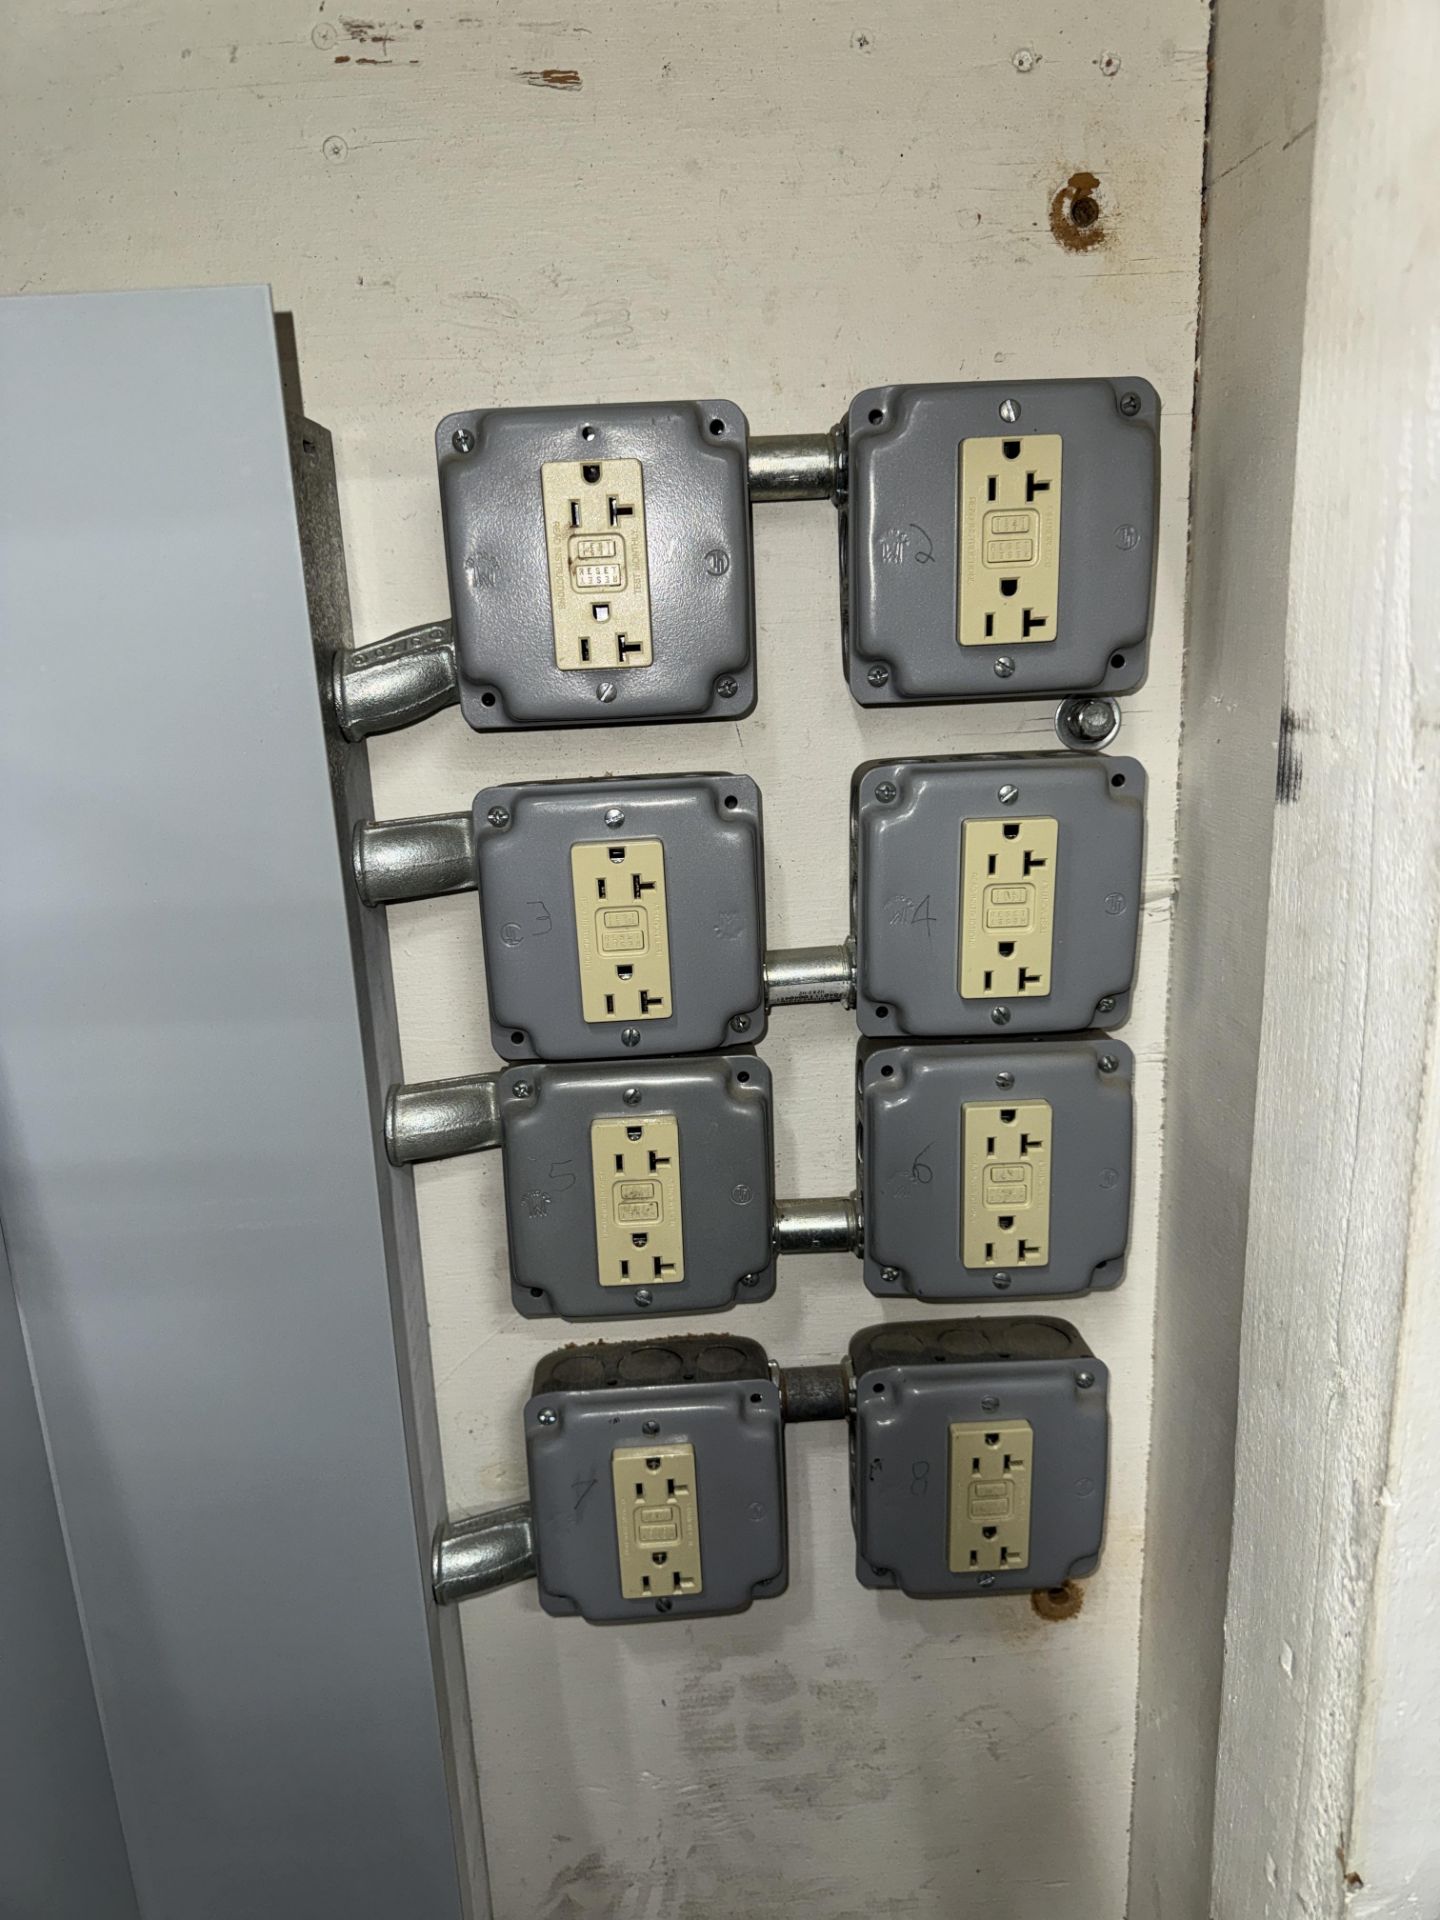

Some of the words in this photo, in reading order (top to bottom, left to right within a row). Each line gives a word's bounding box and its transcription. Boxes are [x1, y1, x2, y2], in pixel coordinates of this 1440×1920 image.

[908, 522, 936, 564] 2
[578, 566, 617, 575] RESET
[526, 900, 553, 936] 3
[910, 894, 937, 938] 4
[548, 1159, 576, 1192] 5
[911, 1141, 937, 1184] 6
[911, 1460, 930, 1496] 8
